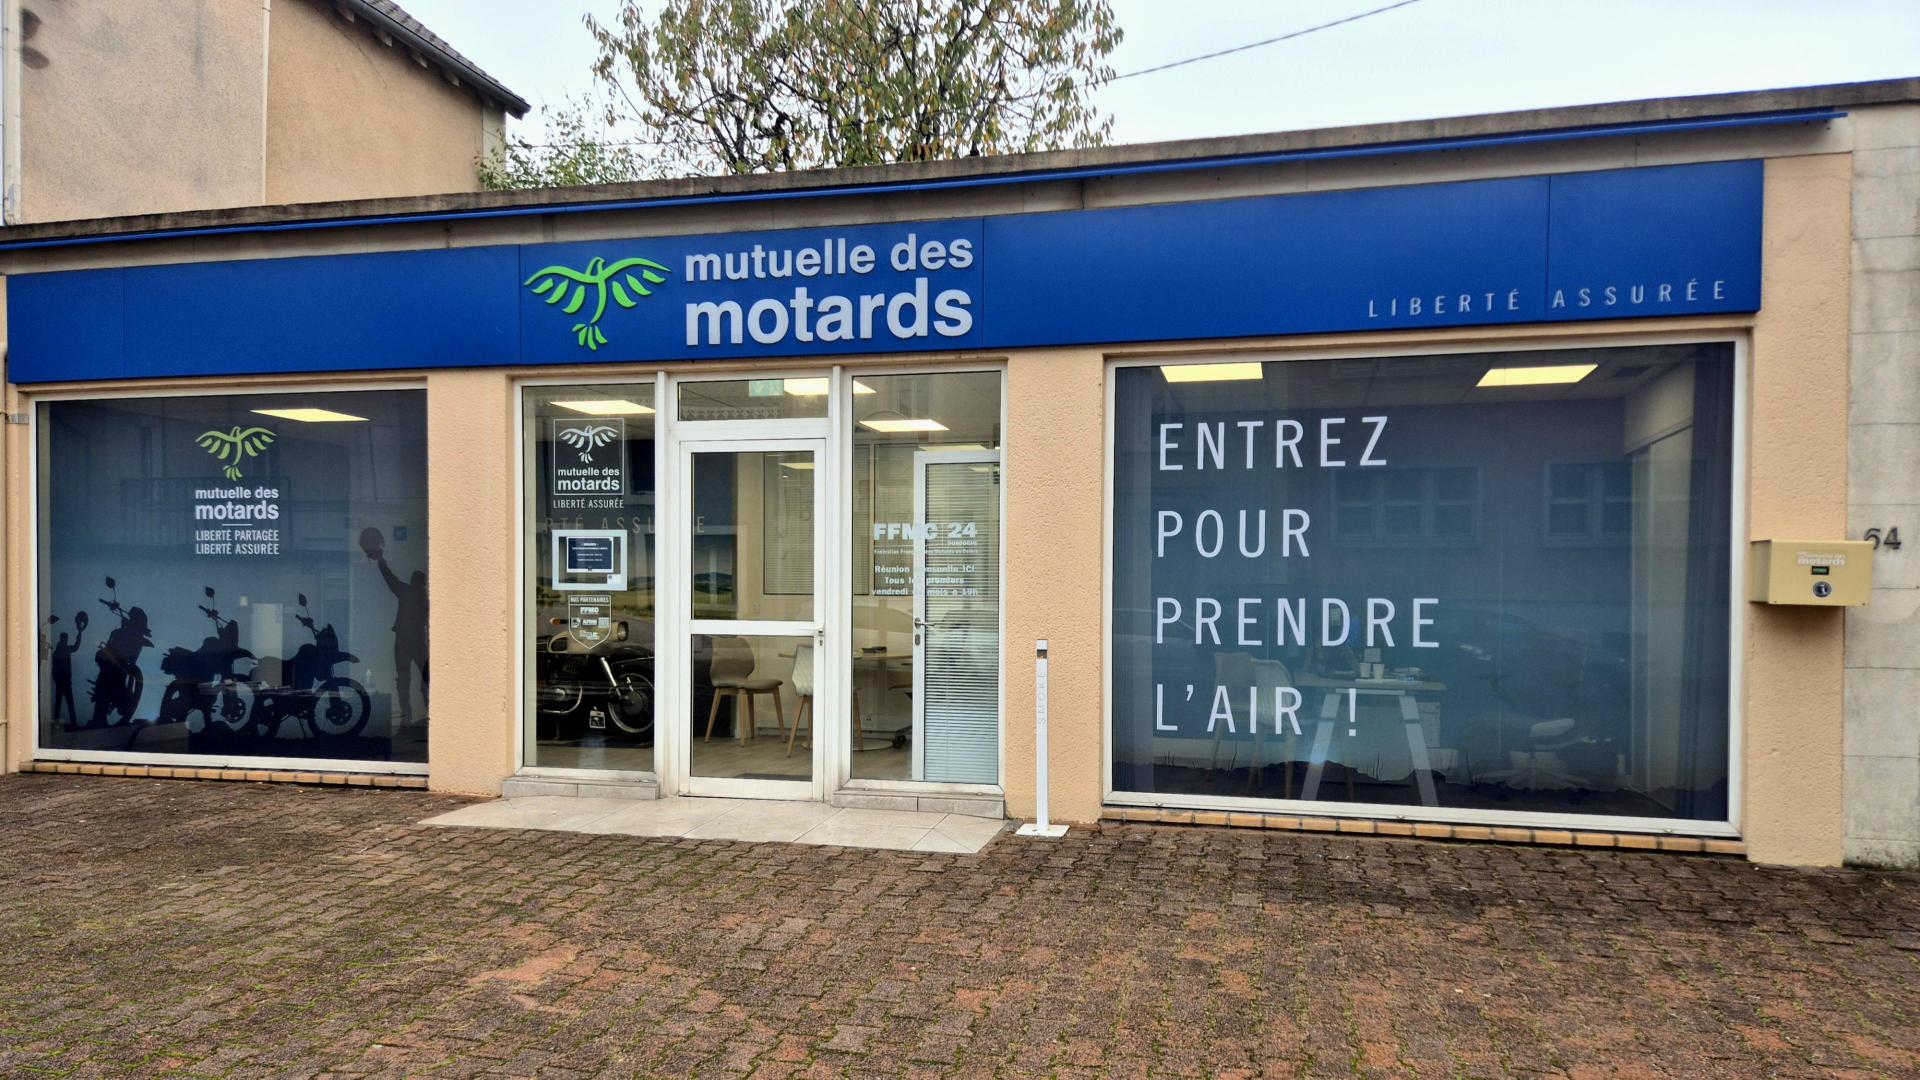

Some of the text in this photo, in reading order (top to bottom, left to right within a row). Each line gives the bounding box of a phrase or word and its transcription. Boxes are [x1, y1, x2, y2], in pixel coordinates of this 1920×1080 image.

[686, 233, 973, 281] mutuelle des
[1369, 279, 1725, 317] LIBERTÉ ASSURÉE
[686, 277, 973, 345] motards
[1159, 416, 1388, 470] ENTREZ
[557, 467, 620, 476] mutuelle des
[195, 486, 279, 499] mutuelle des
[557, 477, 620, 491] motards
[195, 500, 279, 520] motards
[553, 498, 624, 509] LIBERTÉ ASSURÉE
[196, 529, 280, 541] LIBERTÉ PARTAGÉE
[948, 522, 977, 539] 24
[1157, 509, 1310, 558] POUR
[1863, 526, 1901, 550] 64
[196, 542, 280, 554] LIBERTÉ ASSURÉE
[875, 565, 910, 573] Réunion
[885, 576, 905, 584] Tous
[872, 587, 908, 596] vendredi
[1156, 598, 1439, 648] PRENDRE
[1156, 683, 1357, 737] L'AIR !
